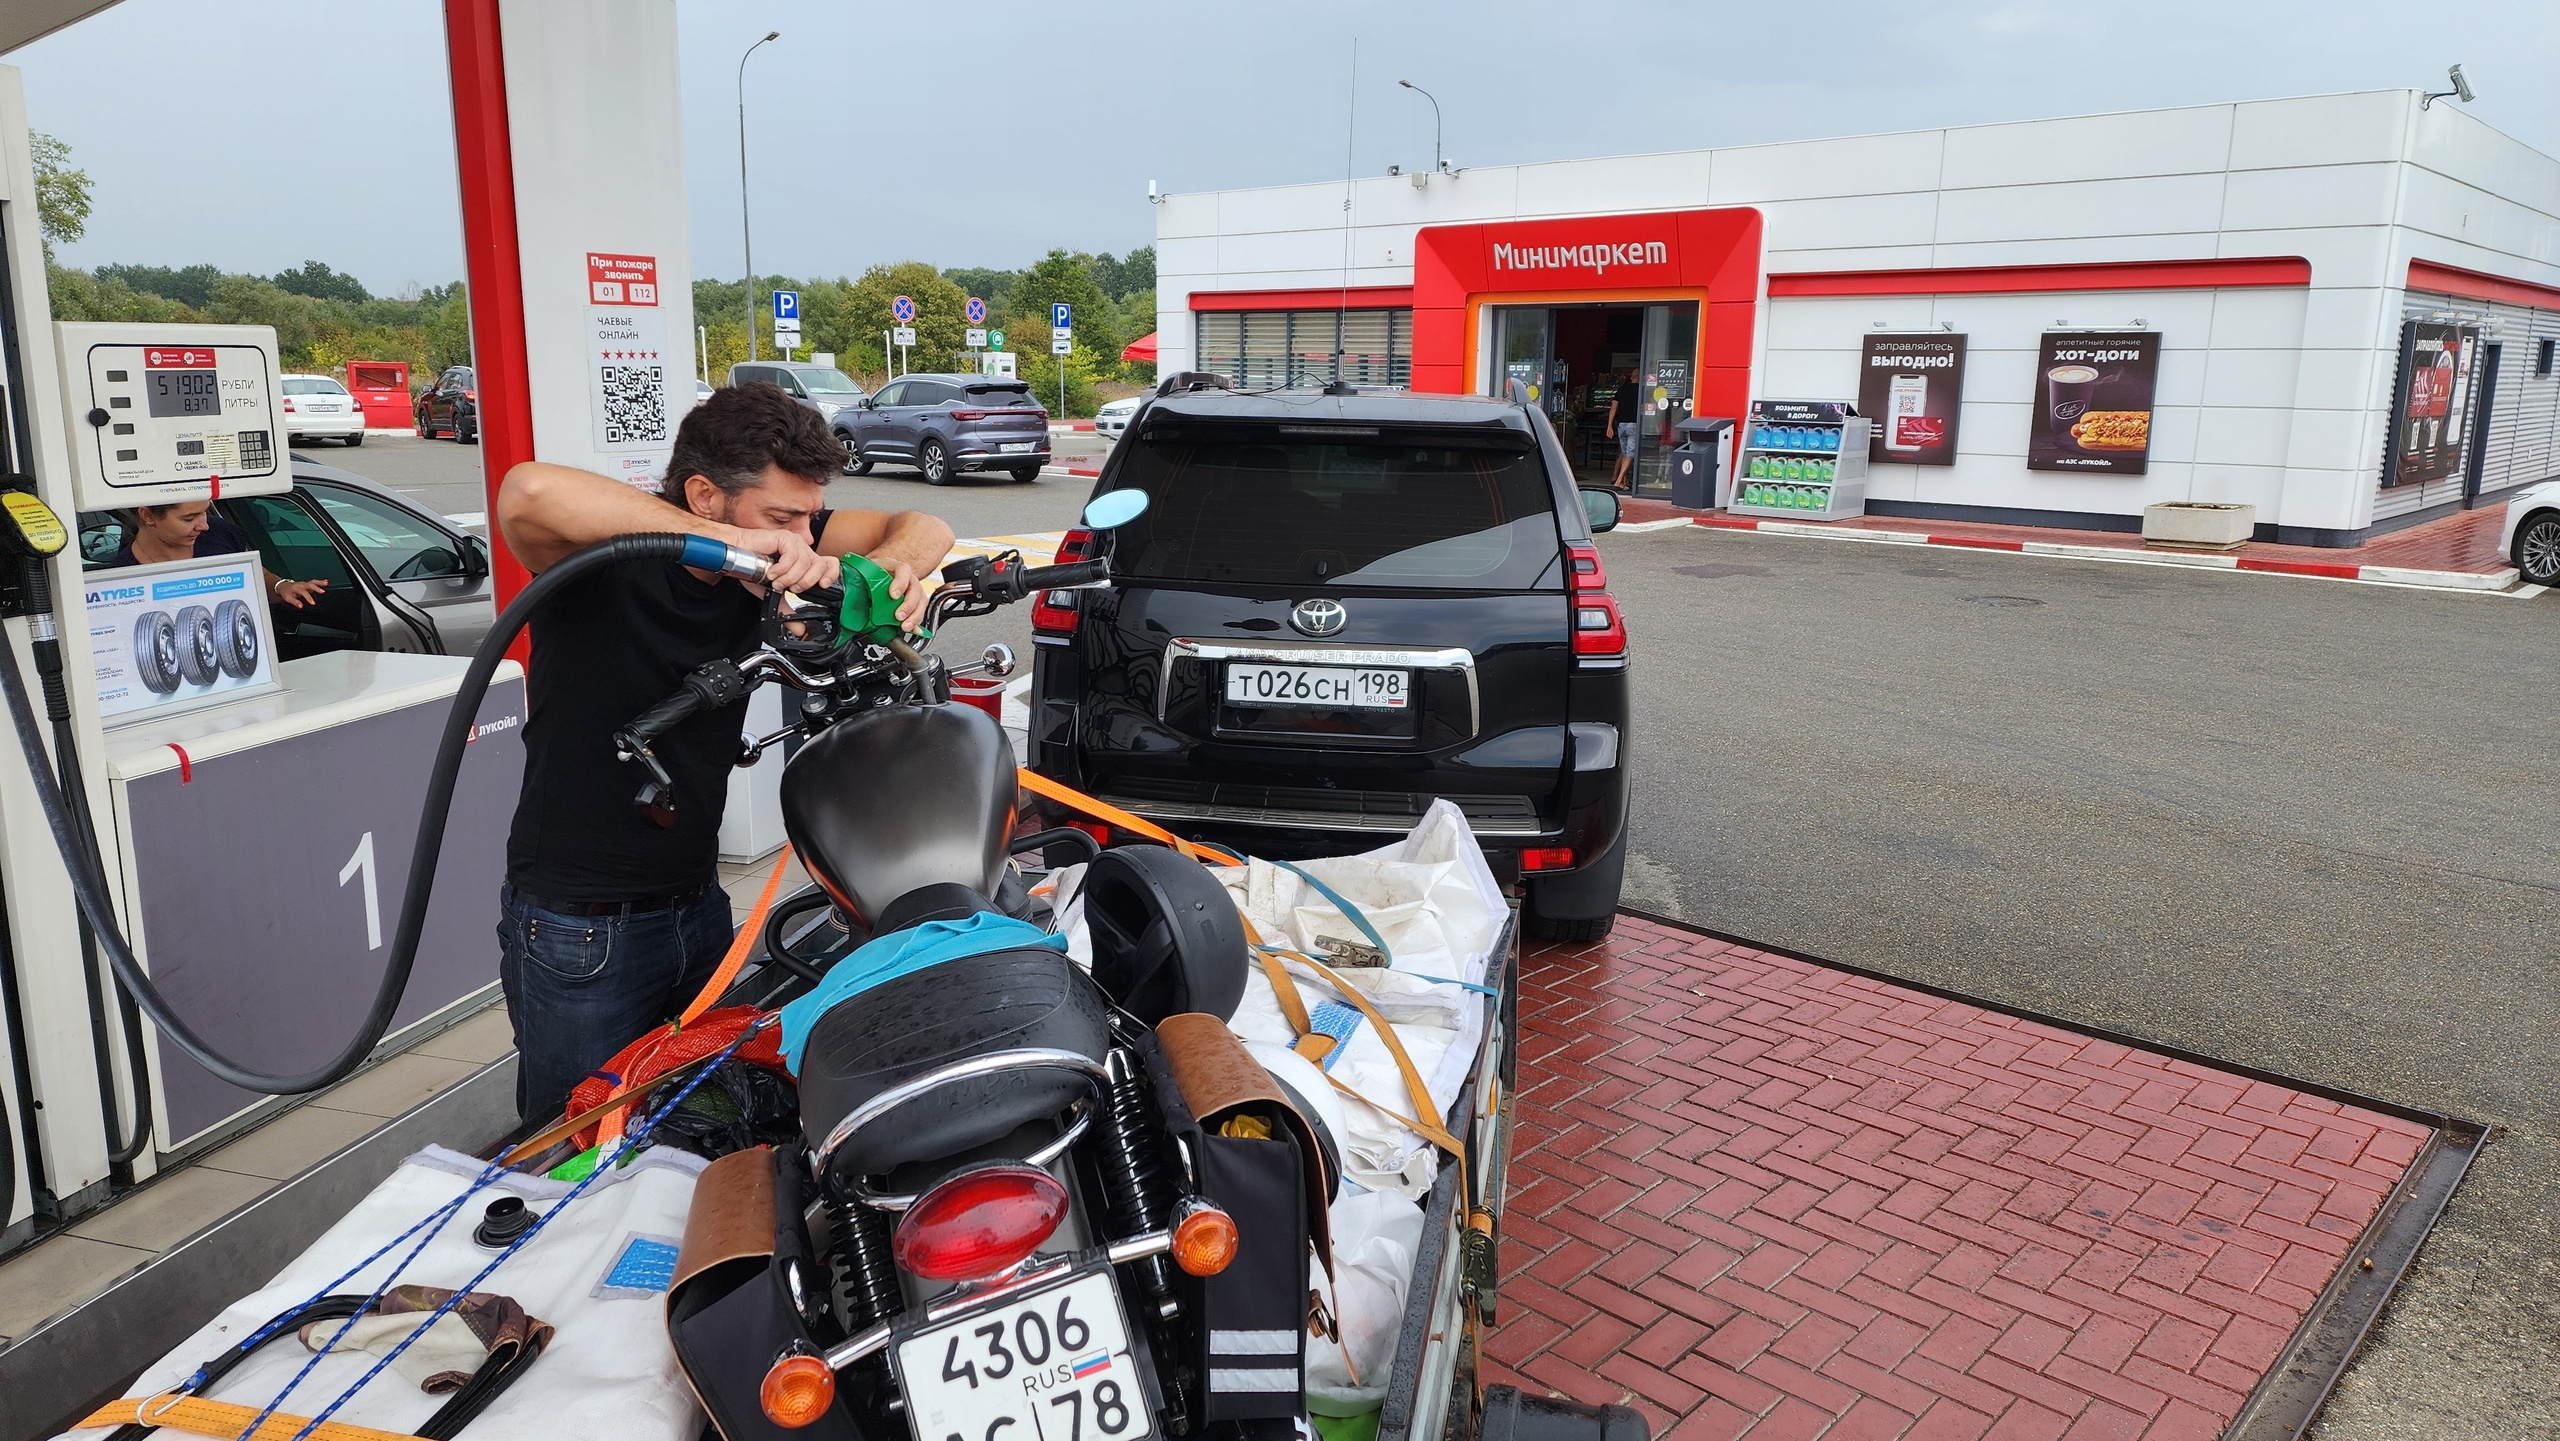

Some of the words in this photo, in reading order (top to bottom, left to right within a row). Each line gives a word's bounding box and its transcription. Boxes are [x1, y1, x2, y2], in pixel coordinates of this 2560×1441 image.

[590, 256, 613, 269] При
[615, 260, 653, 272] пожаре
[1493, 241, 1667, 275] Минимаркет
[604, 271, 644, 280] звонить
[602, 287, 614, 297] 01
[634, 288, 650, 298] 112
[780, 294, 794, 316] P
[597, 316, 632, 326] ЧАЕВЫЕ
[1058, 307, 1068, 326] P
[598, 328, 639, 340] ОНЛАЙН
[1874, 342, 1954, 352] заправляйтесь
[1871, 352, 1955, 369] выгодно!
[1658, 368, 1684, 378] 24/7
[222, 380, 255, 390] РУБЛИ
[224, 398, 258, 408] ЛИТРЫ
[2078, 458, 2112, 466] «ЛУКОЙЛ»
[8, 502, 42, 510] ВНИМАНИЕ!
[37, 528, 62, 536] ПОЛНОГО
[156, 584, 188, 593] ХОДИМОСТЬ
[188, 582, 196, 590] ДО
[198, 578, 214, 588] 700
[216, 576, 232, 585] 000
[102, 586, 145, 601] TYRES
[86, 602, 118, 610] ВЕРЕННОСТЬ.
[118, 598, 146, 606] ЛИДЕРСТВО
[1225, 647, 1272, 658] LAND
[1273, 649, 1348, 662] CRUISER
[1352, 652, 1411, 664] PRADO
[1238, 670, 1350, 700] Т026СН
[1358, 672, 1400, 694] 198
[1366, 696, 1388, 704] RUS
[478, 716, 518, 737] ЛУКОЙЛ
[338, 830, 382, 951] 1
[942, 1296, 1090, 1389] 4306
[1022, 1364, 1072, 1396] RUS
[1051, 1379, 1130, 1441] 78
